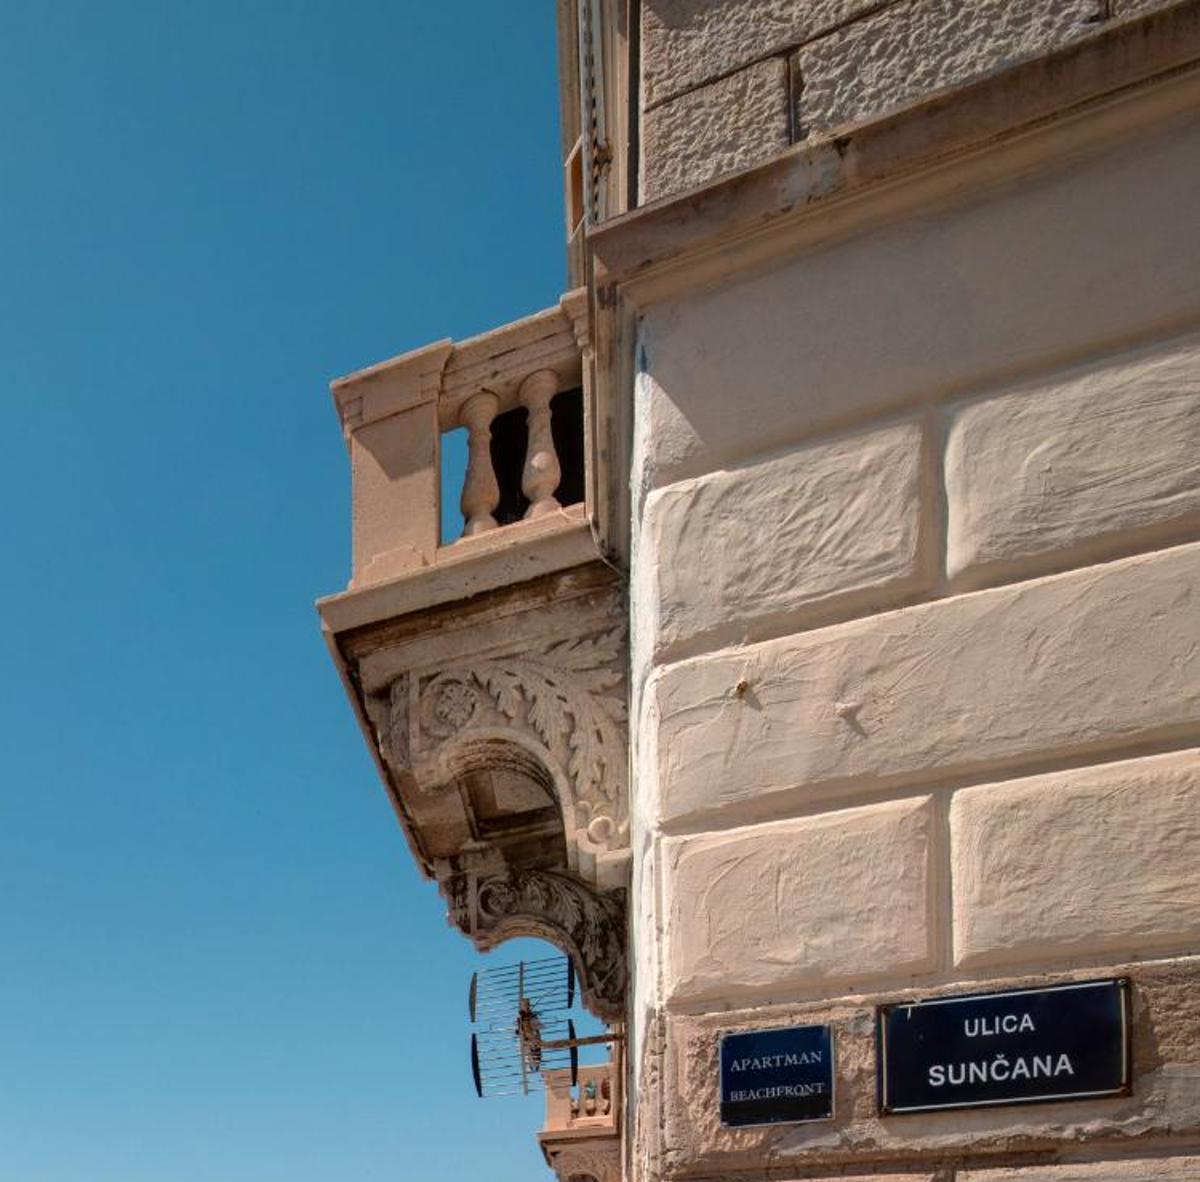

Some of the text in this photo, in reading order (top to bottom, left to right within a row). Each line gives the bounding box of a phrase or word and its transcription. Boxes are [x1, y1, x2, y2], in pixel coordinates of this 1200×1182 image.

[965, 1013, 1035, 1037] ULICA
[730, 1051, 822, 1072] APARTMAN
[929, 1054, 1074, 1086] SUNČANA
[730, 1083, 824, 1101] BEACHFRONT
